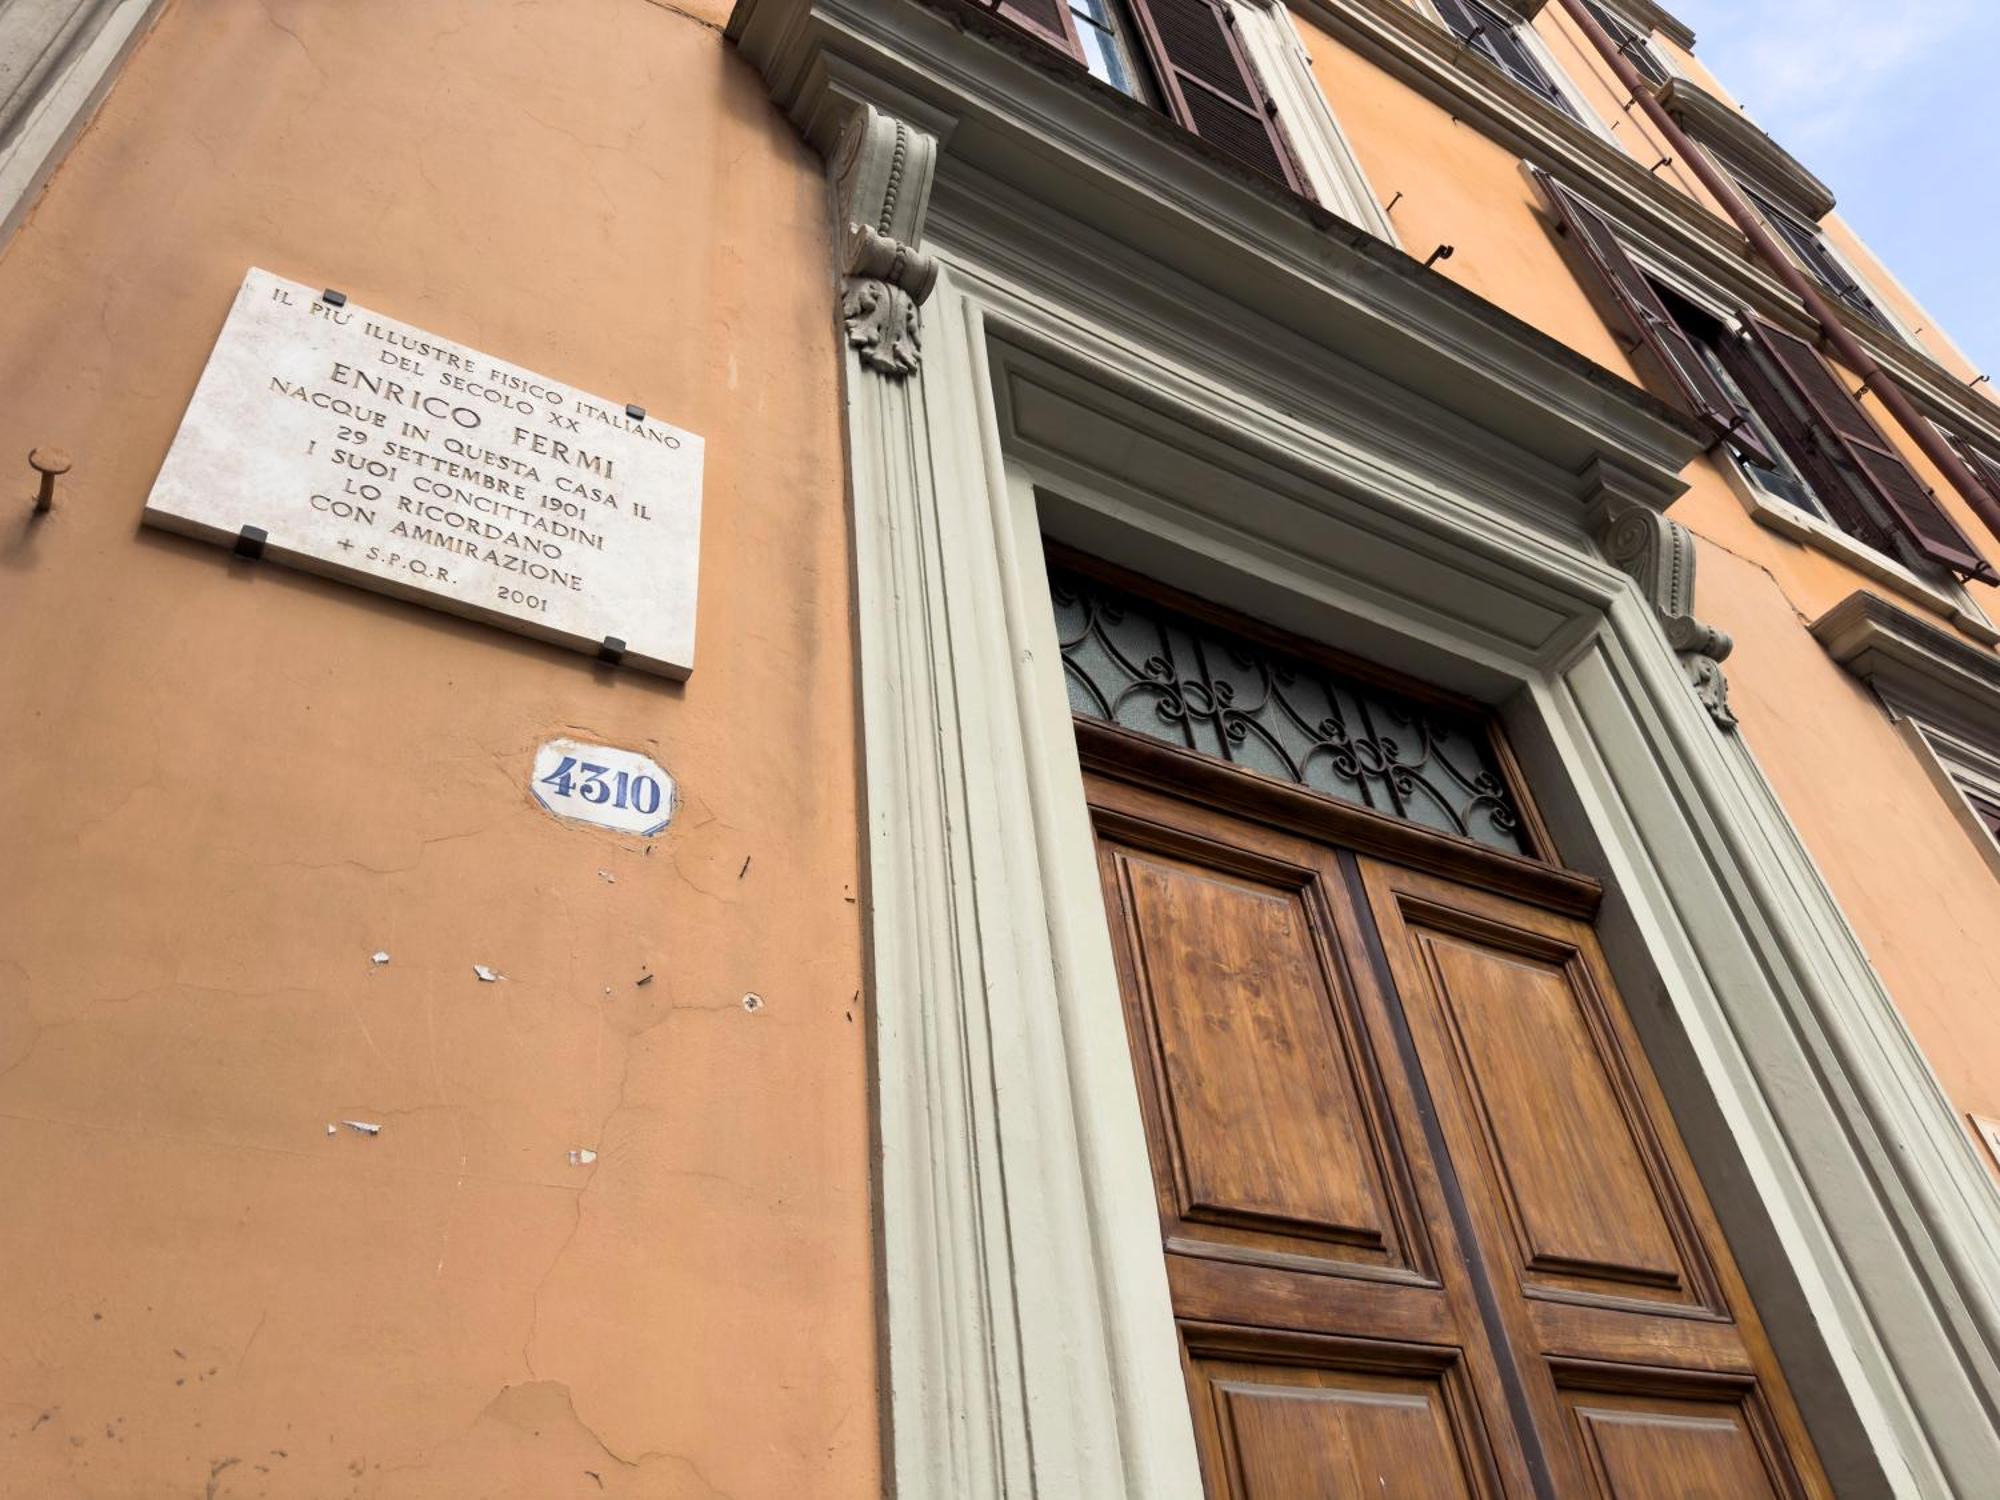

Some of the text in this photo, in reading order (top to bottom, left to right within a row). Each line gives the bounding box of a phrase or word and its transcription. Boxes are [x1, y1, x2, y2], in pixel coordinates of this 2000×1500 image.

[272, 288, 293, 306] IL
[364, 323, 476, 373] ILLUSTRE
[490, 369, 563, 404] FISICO
[576, 401, 681, 449] ITALIANO
[379, 350, 580, 433] DEL SECOLO XX
[268, 376, 651, 520] NACQUE IN QUESTA CASA IL
[331, 362, 615, 480] ENRICO FERMI
[307, 440, 604, 551] I SUOI CONCITTADINI
[337, 425, 586, 521] 29 SETTEMBRE 1901
[343, 478, 562, 559] LO RICORDANO
[310, 494, 583, 591] CON AMMIRAZIONE
[366, 547, 547, 612] S.P.Q.R. 2001
[541, 757, 661, 814] 4310
